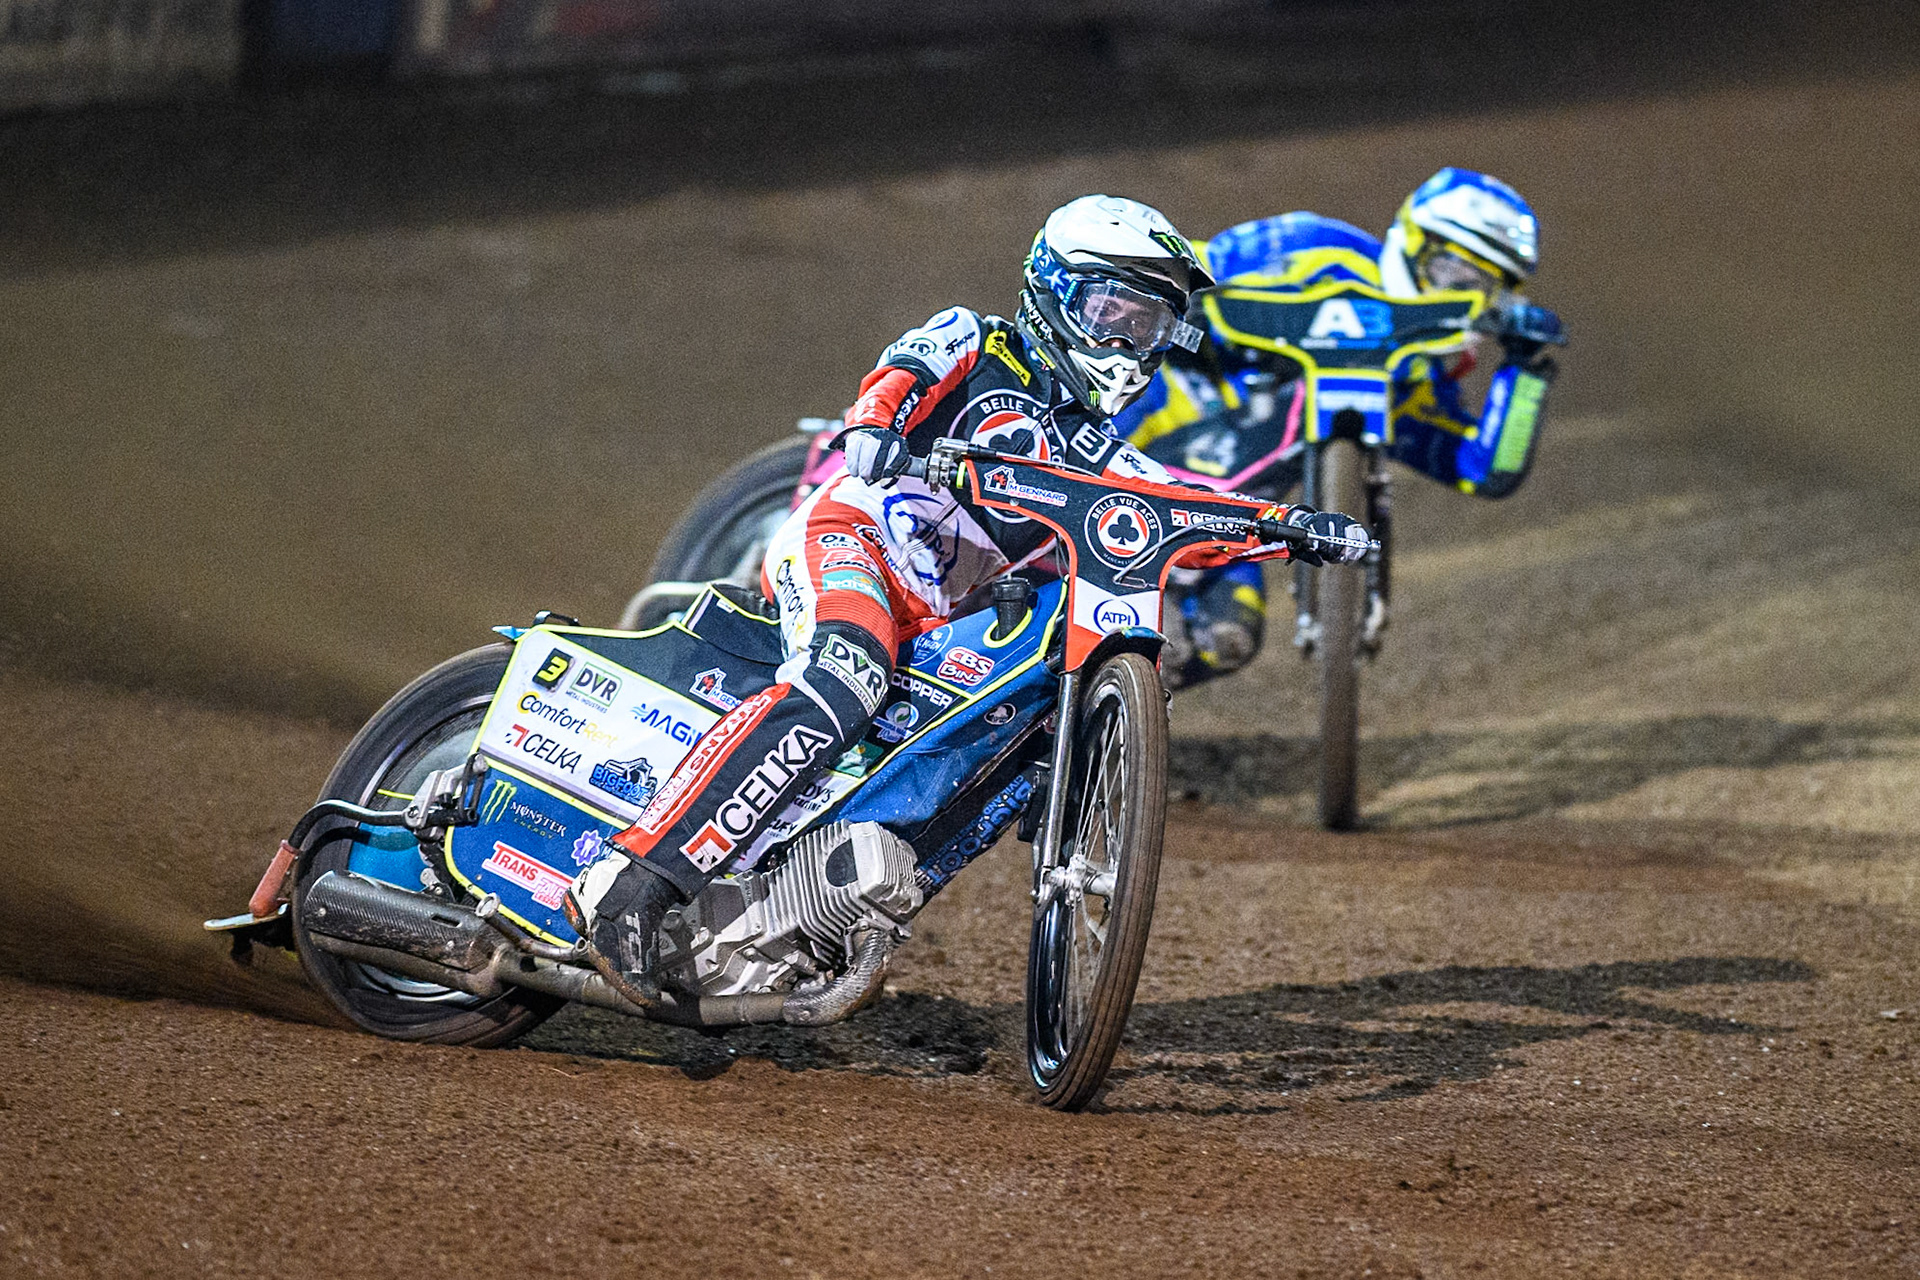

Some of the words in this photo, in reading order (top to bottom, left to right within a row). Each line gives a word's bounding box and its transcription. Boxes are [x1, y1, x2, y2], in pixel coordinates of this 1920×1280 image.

[980, 397, 1024, 415] BELLE
[1032, 406, 1054, 436] VUE
[1010, 484, 1018, 492] M
[1020, 486, 1066, 502] GENNARD
[1092, 498, 1116, 520] BELLE
[1119, 497, 1140, 509] VUE
[1140, 508, 1158, 530] ACES
[1101, 611, 1131, 626] ATPI
[828, 641, 882, 701] DVR
[940, 663, 981, 682] BINS
[948, 648, 993, 675] CBS
[575, 667, 618, 702] DVR
[891, 672, 953, 709] COPPER
[517, 690, 587, 735] Comfort
[583, 722, 619, 749] Rent
[523, 733, 583, 774] CELKA
[592, 765, 649, 799] BIGFOOT
[719, 728, 832, 837] CELKA
[510, 801, 567, 838] MONSTER
[492, 843, 539, 882] TRANS
